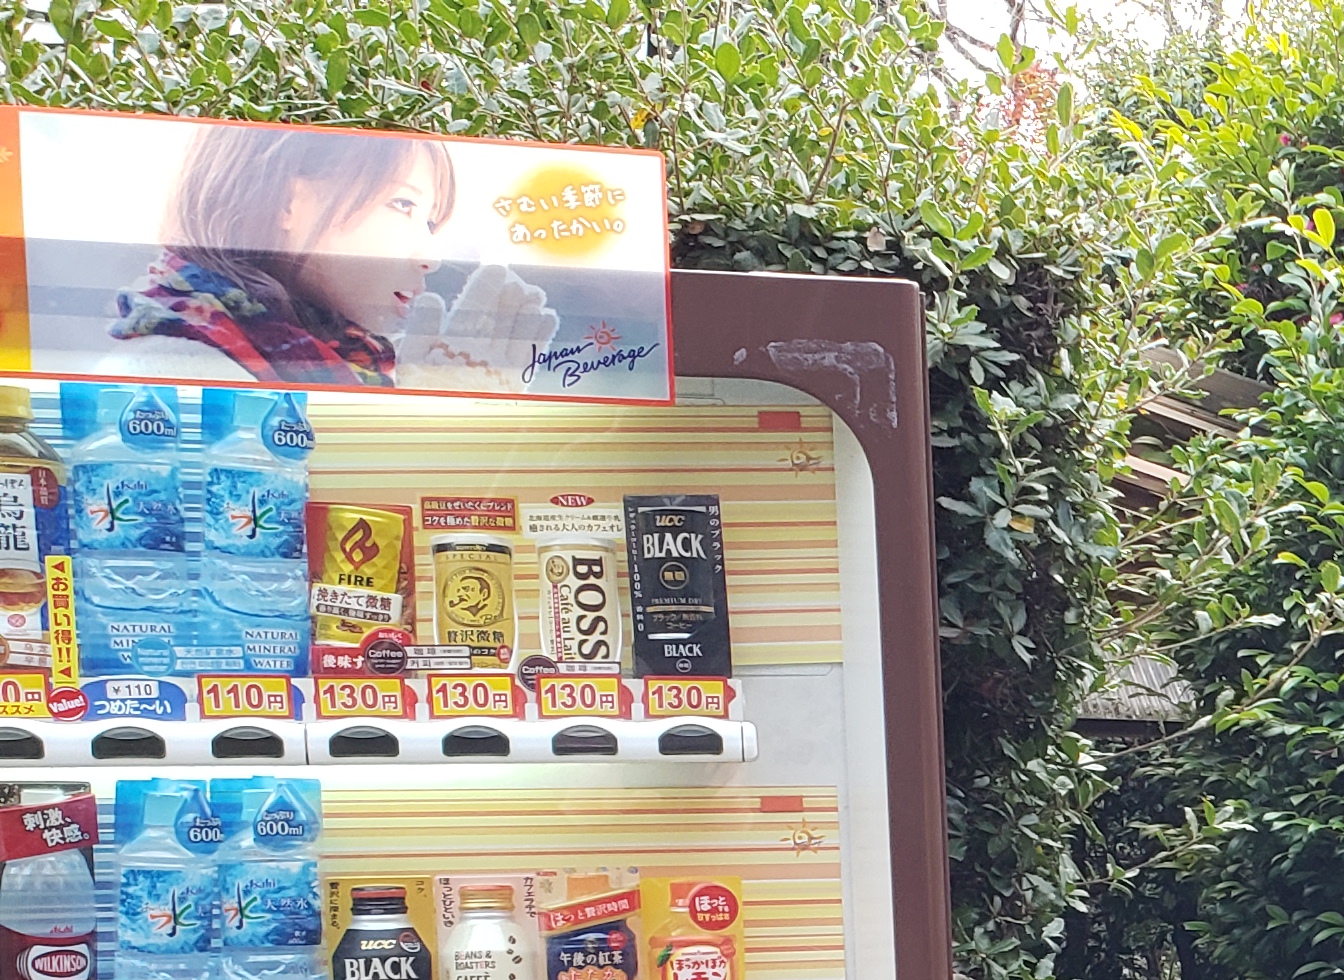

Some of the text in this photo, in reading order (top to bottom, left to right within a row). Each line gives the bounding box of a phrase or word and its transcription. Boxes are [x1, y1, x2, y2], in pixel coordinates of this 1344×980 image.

[495, 184, 625, 215] さむい季節に
[511, 217, 624, 242] あったかい。
[522, 343, 660, 388] Japan Beverage
[129, 420, 177, 437] 600ml
[116, 480, 147, 492] Asahi
[558, 495, 588, 506] NEW
[528, 523, 623, 535] 癒される大人のカフェオレ
[643, 532, 707, 560] BLACK
[708, 505, 723, 574] 男のブラック
[338, 573, 374, 588] FIRE
[632, 564, 644, 598] 100%
[317, 587, 392, 612] 挽きたて微糖
[571, 555, 611, 661] BOSS
[51, 576, 73, 662] お買い得!!
[111, 624, 174, 636] NATURAL
[244, 630, 300, 643] NATURAL
[447, 629, 505, 645] 贅沢微糖
[246, 644, 300, 656] MINERAL
[369, 649, 403, 659] Coffee
[664, 644, 703, 657] BLACK
[253, 658, 293, 669] WATER
[322, 654, 366, 669] 後味す
[522, 665, 557, 676] Coffee
[112, 684, 153, 697] ¥110
[205, 683, 285, 711] 110円
[321, 682, 398, 711] 130円
[434, 682, 508, 711] 130円
[543, 682, 615, 711] 130円
[651, 683, 721, 712] 130円
[49, 695, 84, 713] Value!
[22, 807, 72, 832] 刺激、
[42, 823, 90, 848] 快感。
[256, 821, 303, 836] 600ml
[245, 878, 276, 890] Asahi
[265, 898, 309, 910] 天然水
[695, 896, 727, 912] ほっと
[550, 899, 629, 928] ほっと贅沢時間
[454, 948, 491, 960] BEANS &
[558, 950, 624, 968] 午後の紅茶
[344, 955, 419, 980] BLACK
[455, 958, 496, 970] ROASTERS
